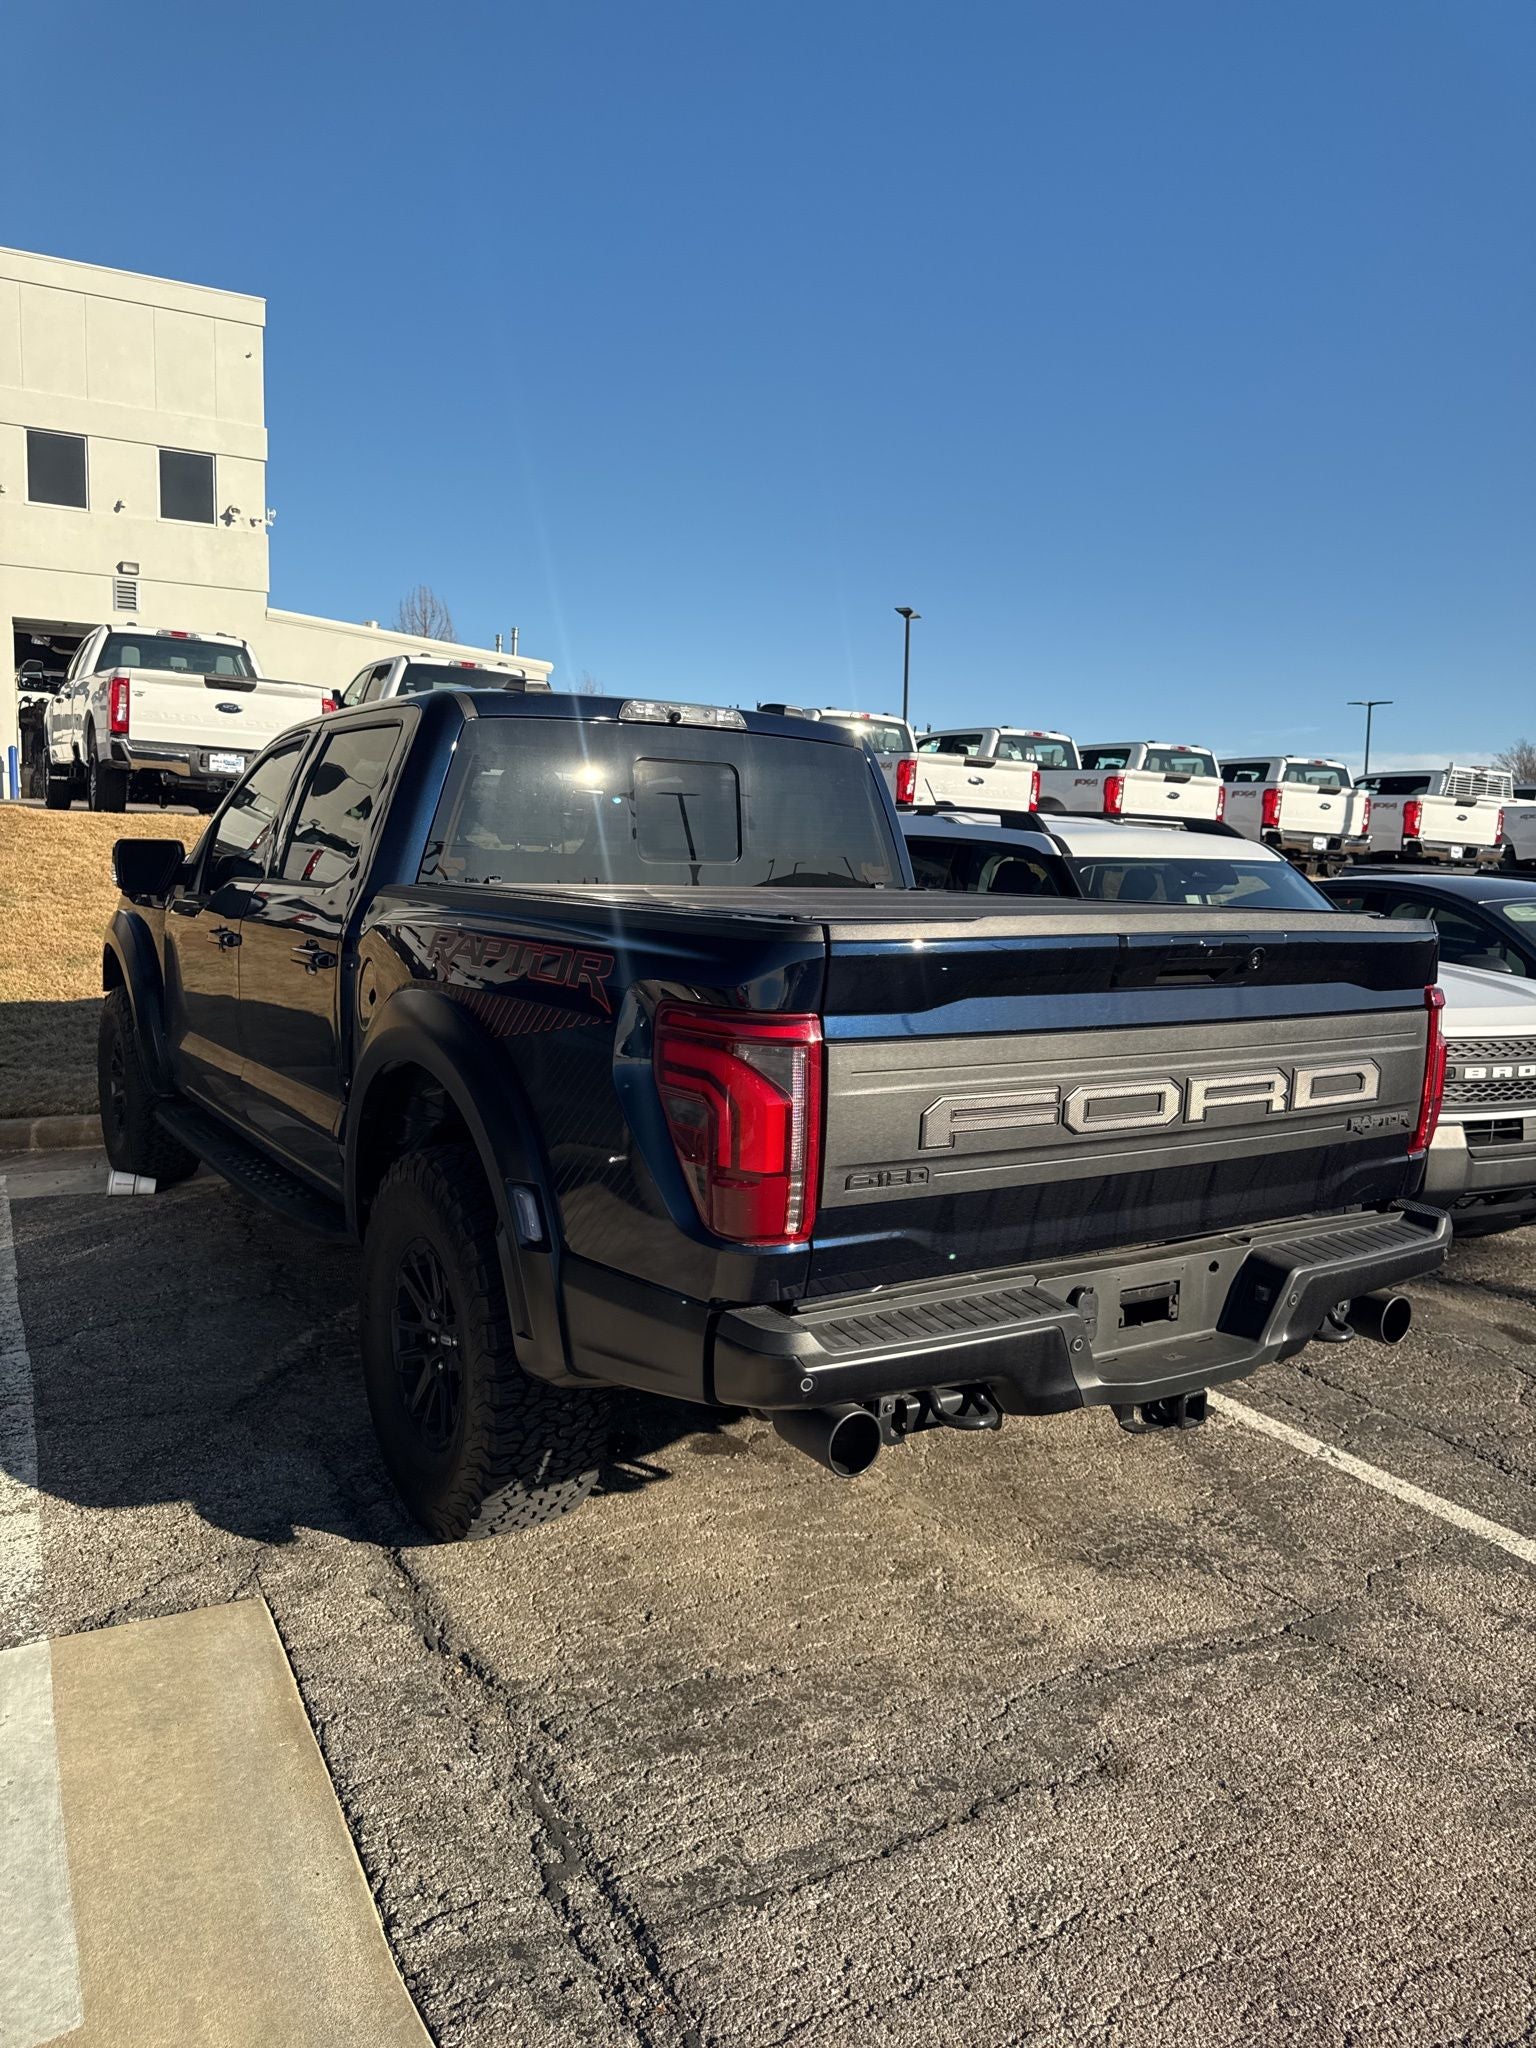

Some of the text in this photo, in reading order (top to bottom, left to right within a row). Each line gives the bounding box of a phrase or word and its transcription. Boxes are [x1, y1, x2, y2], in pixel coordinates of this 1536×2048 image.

[1074, 778, 1099, 787] FX4
[1231, 790, 1257, 798] FX4
[1372, 802, 1398, 810] FX4
[426, 929, 615, 1015] RAPTOR
[918, 1058, 1382, 1150] FORD
[1345, 1110, 1410, 1135] RAPTOR
